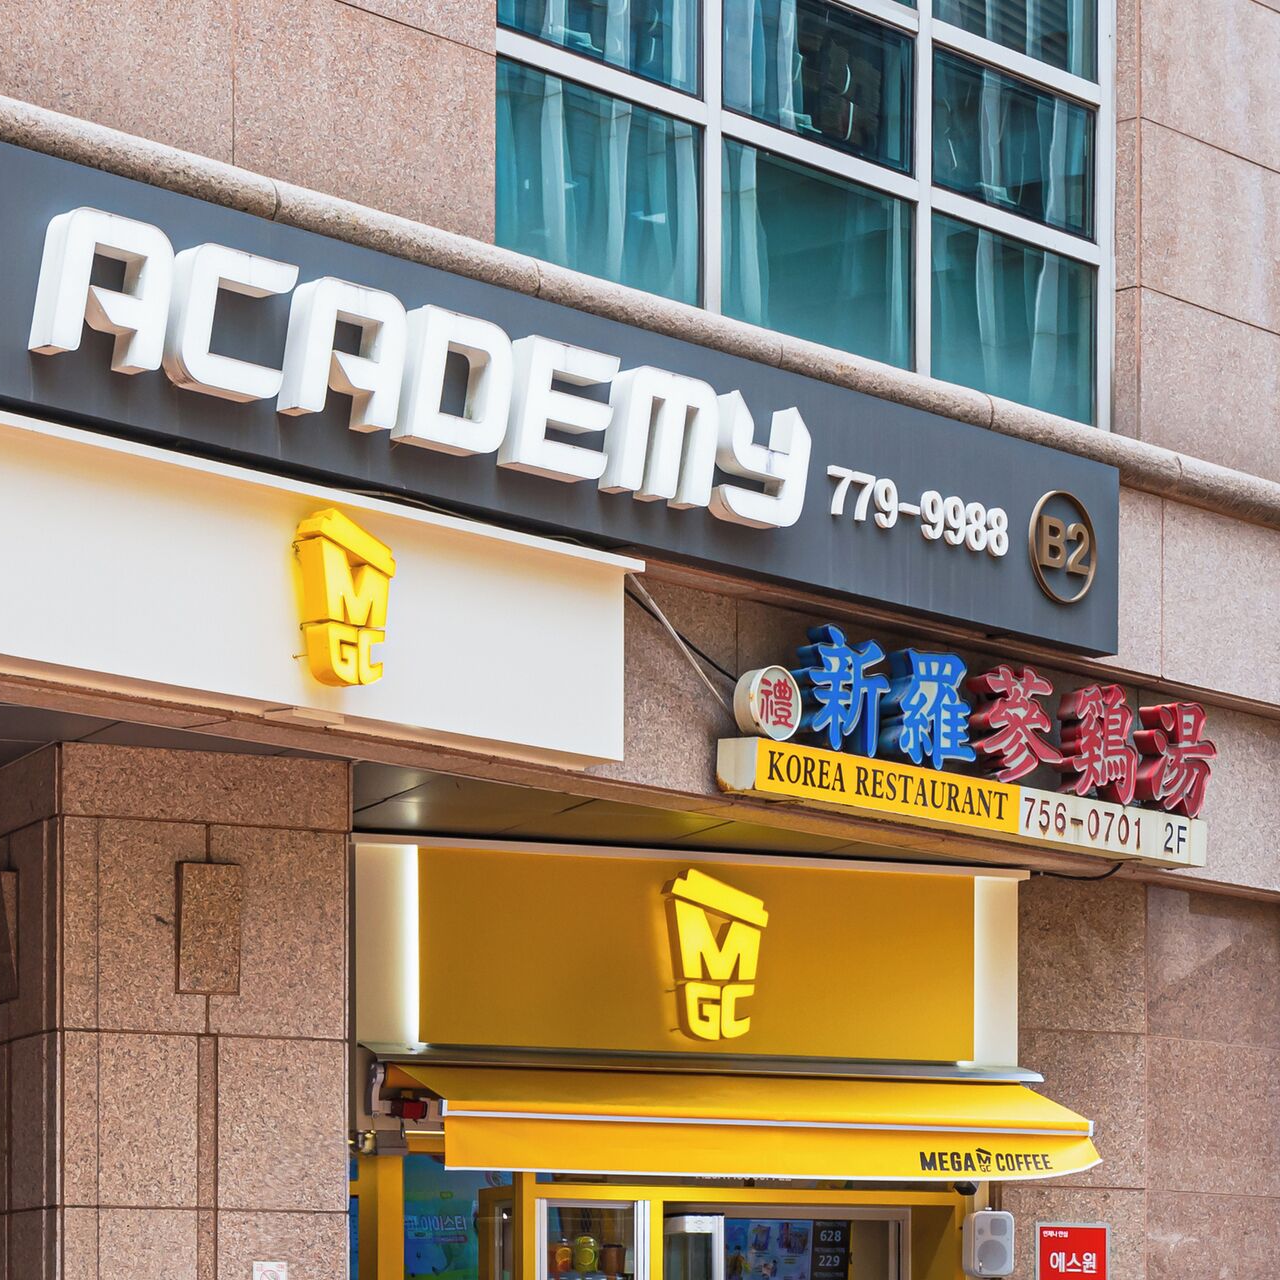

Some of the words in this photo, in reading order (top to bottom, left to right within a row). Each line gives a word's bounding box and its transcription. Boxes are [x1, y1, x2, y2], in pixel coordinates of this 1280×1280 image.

[29, 206, 812, 529] ACADEMY
[827, 465, 1010, 557] 779-9988
[1038, 513, 1092, 579] B2
[767, 750, 846, 793] KOREA
[856, 766, 1010, 822] RESTAURANT
[1024, 796, 1142, 850] 756-0701
[1162, 822, 1188, 856] 2F
[920, 1151, 976, 1172] MEGA
[995, 1153, 1054, 1172] COFFEE
[820, 1230, 842, 1242] 628
[819, 1255, 840, 1267] 229
[1049, 1251, 1097, 1274] 에스원
